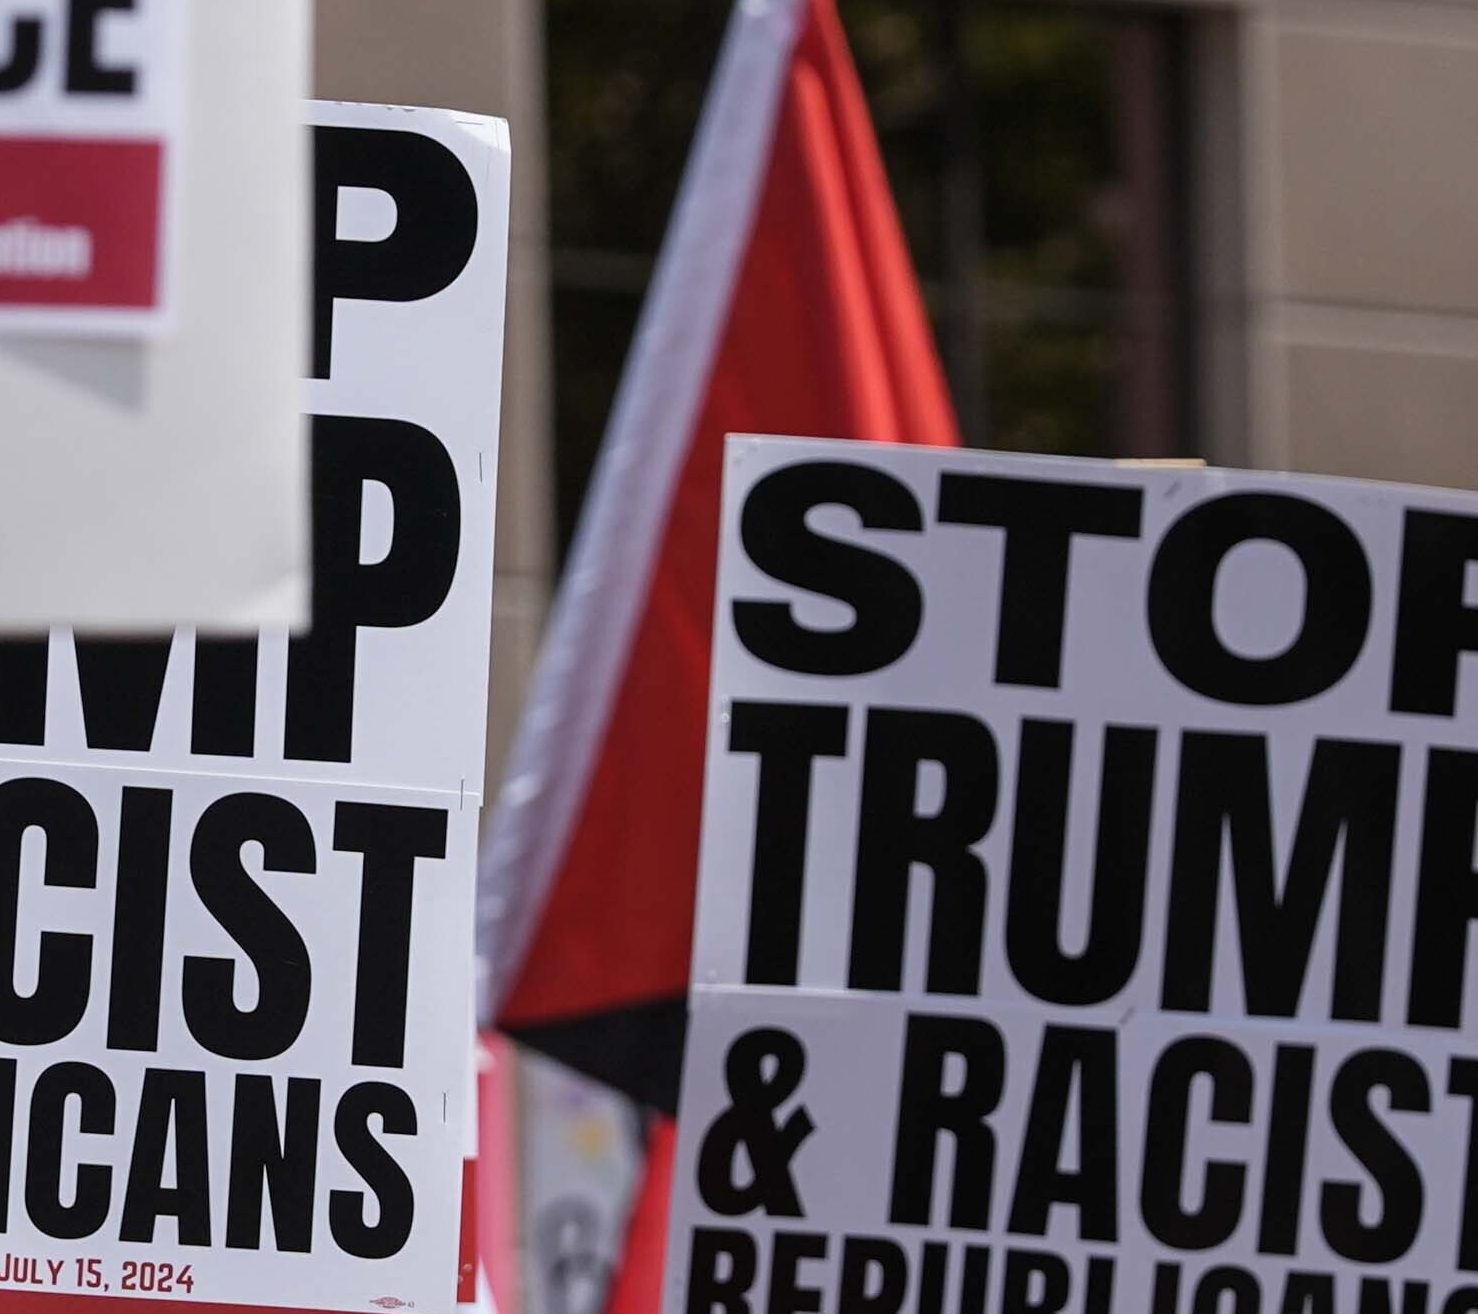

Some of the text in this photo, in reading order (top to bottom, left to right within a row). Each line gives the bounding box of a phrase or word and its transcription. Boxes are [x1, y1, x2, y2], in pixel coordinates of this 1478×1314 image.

[695, 1025, 817, 1219] &
[75, 1258, 111, 1292] 15,
[121, 1260, 195, 1295] 2024
